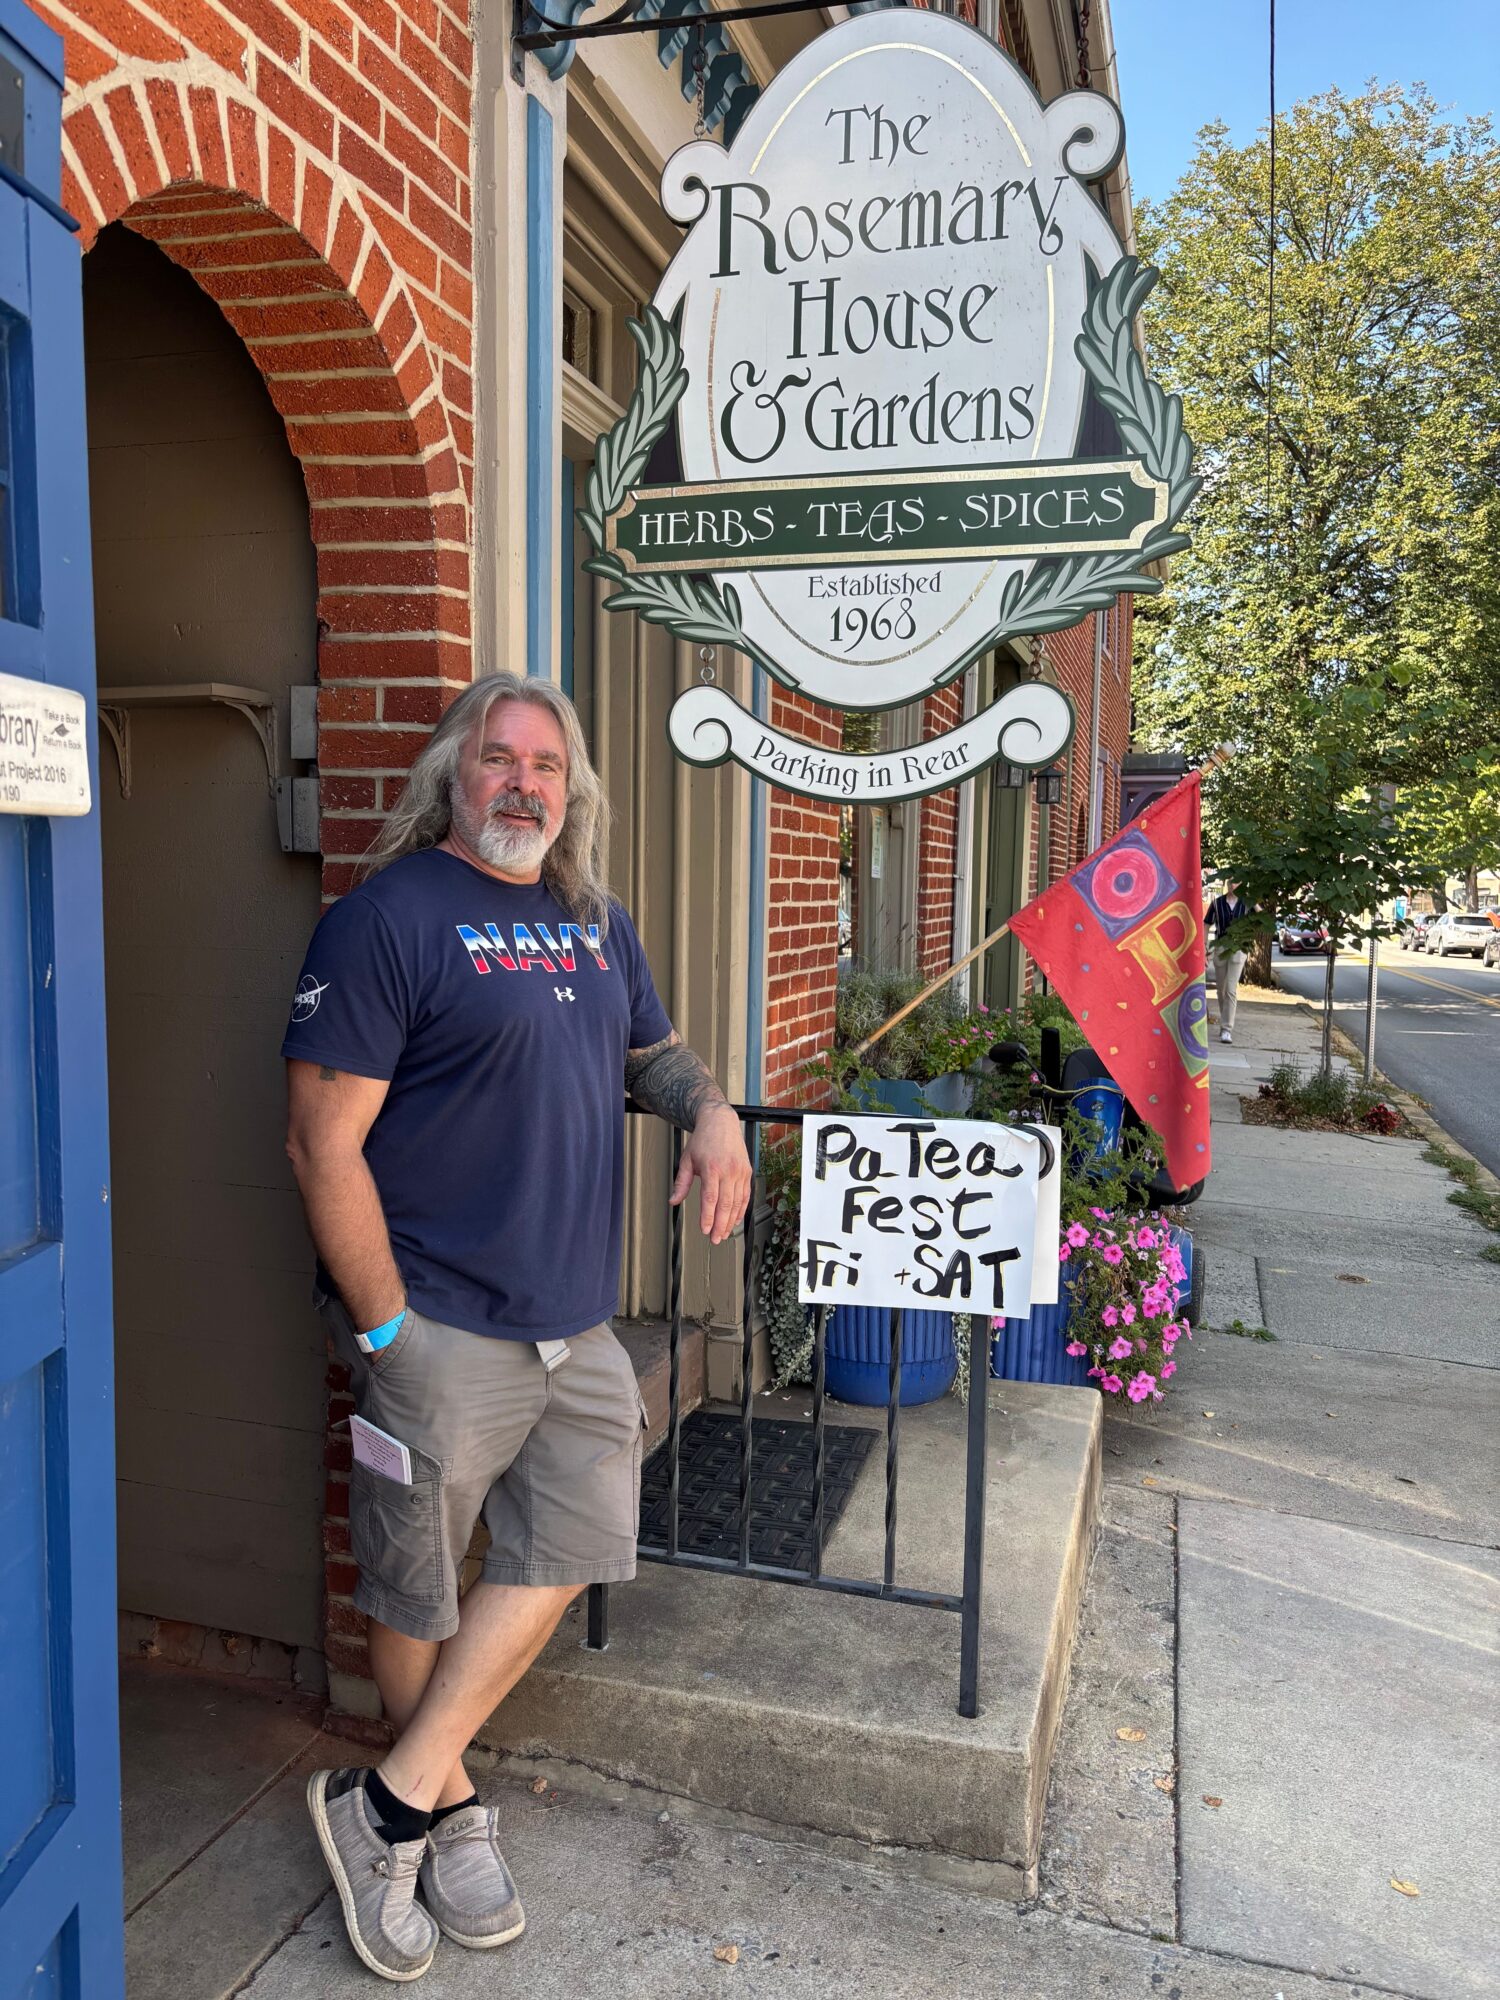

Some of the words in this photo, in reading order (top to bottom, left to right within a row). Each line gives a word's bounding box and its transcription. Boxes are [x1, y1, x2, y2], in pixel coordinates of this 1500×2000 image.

[825, 103, 932, 167] The
[709, 175, 1069, 279] Rosemary
[786, 276, 997, 360] House
[720, 360, 811, 463] &
[804, 371, 1035, 452] Gardens
[639, 506, 775, 546] HERBS
[806, 497, 925, 544] TEAS
[959, 485, 1125, 532] SPICES
[808, 570, 942, 599] Established
[829, 597, 917, 653] 1968
[3, 784, 20, 801] 190
[8, 760, 42, 784] Project
[44, 764, 66, 784] 2016
[750, 734, 859, 794] Parking
[866, 762, 892, 789] in
[901, 738, 970, 784] Rear
[455, 922, 612, 975] NAVY
[814, 1123, 900, 1181] Pa
[886, 1122, 1024, 1180] Tea
[841, 1185, 994, 1241] Fest
[799, 1238, 863, 1293] Fri
